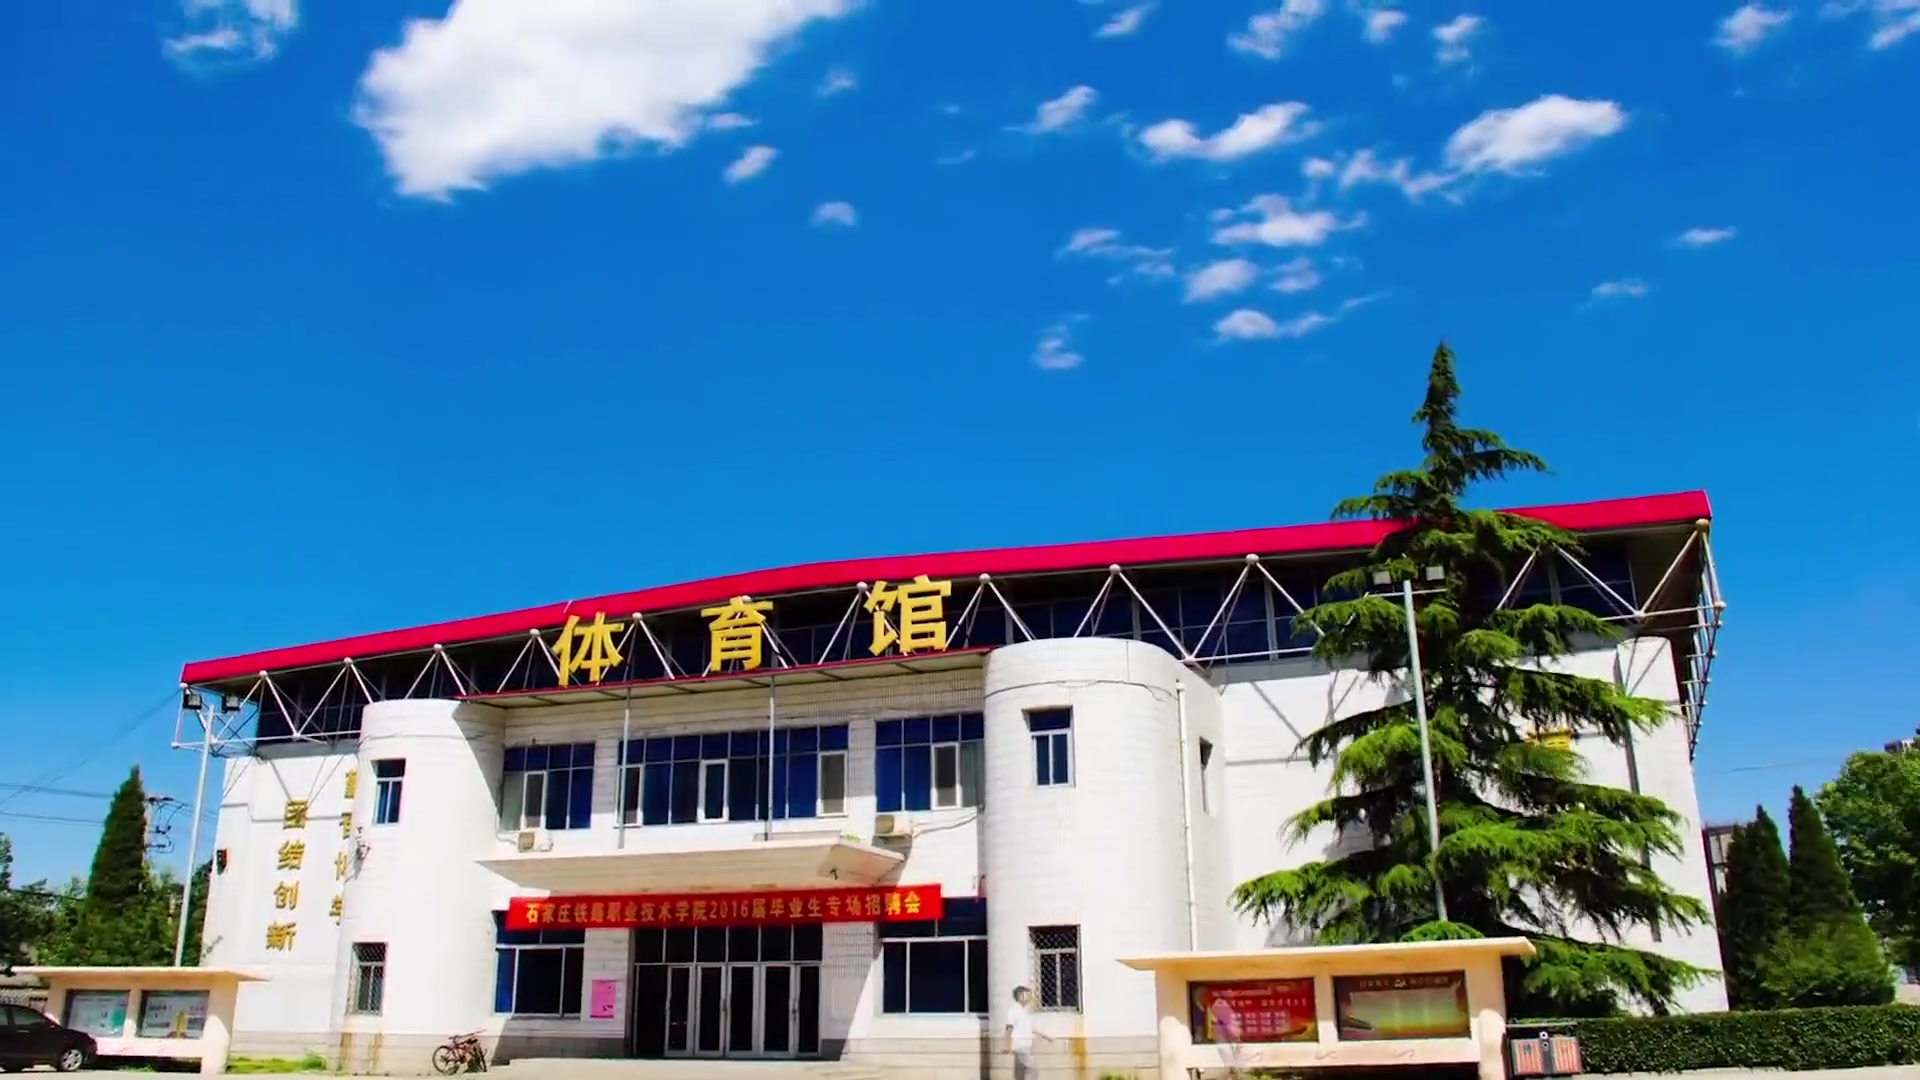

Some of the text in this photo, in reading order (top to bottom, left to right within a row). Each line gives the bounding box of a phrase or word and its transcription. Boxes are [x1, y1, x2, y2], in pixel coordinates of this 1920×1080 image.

[553, 574, 952, 688] 体育馆
[266, 800, 308, 951] 团结创新
